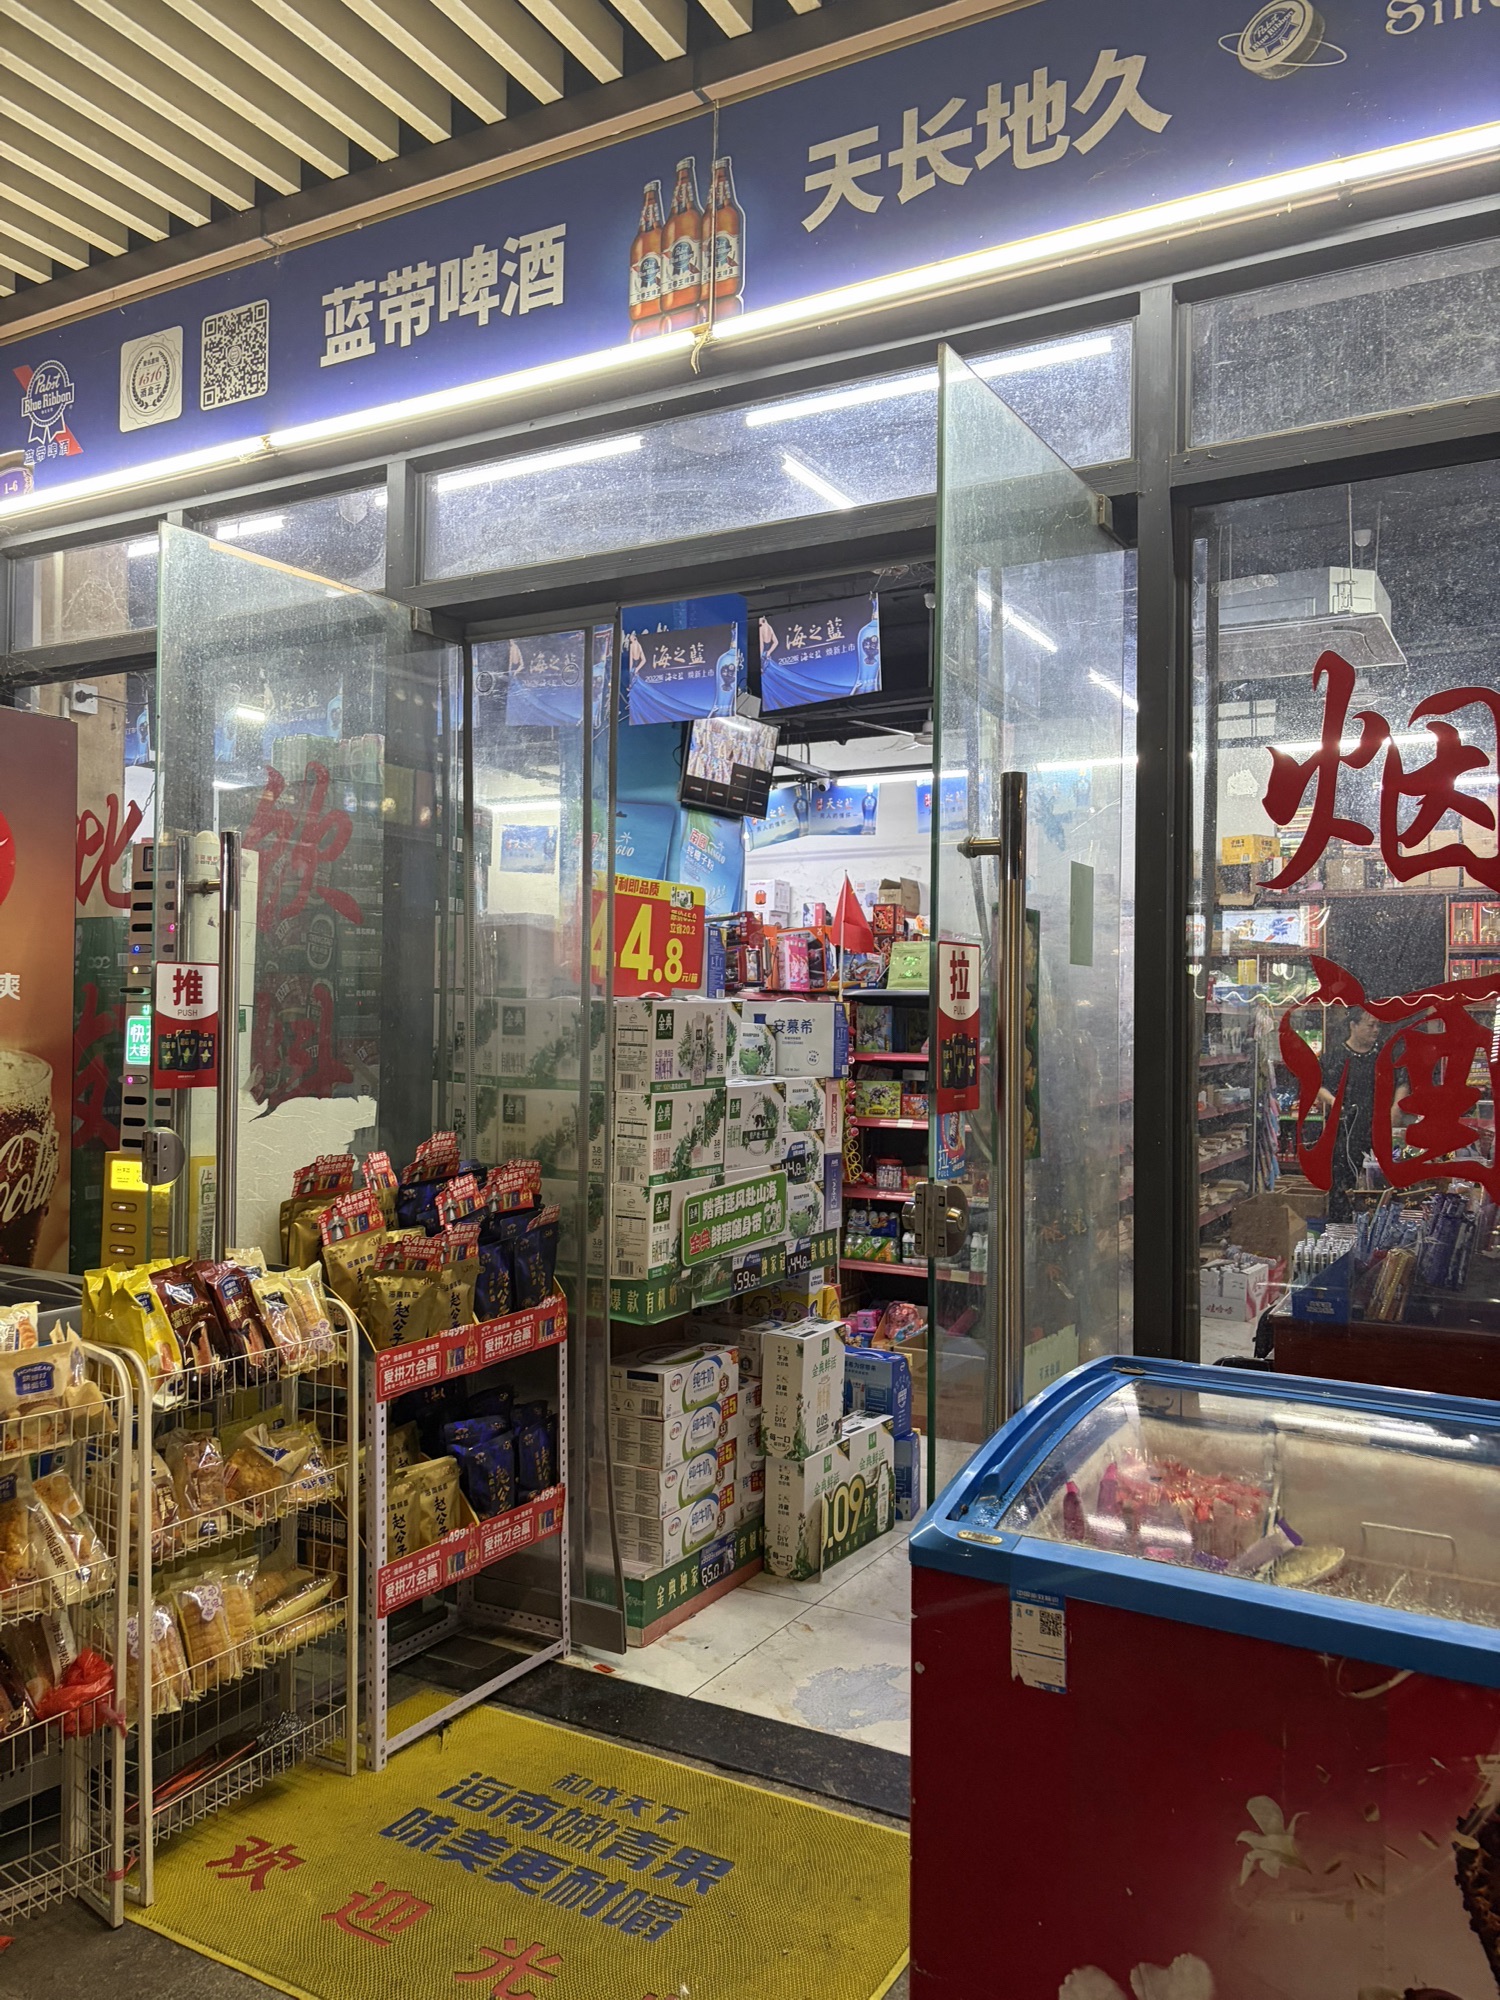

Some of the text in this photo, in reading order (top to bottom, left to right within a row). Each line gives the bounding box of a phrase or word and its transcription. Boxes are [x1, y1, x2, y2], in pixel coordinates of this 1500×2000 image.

[802, 48, 1171, 233] 天长地久
[319, 223, 567, 367] 蓝带啤酒
[34, 373, 61, 395] Pabst
[138, 365, 165, 386] 1516
[24, 391, 72, 414] Blue Ribbon
[172, 968, 203, 1007] 推
[949, 950, 970, 1001] 拉
[177, 1009, 198, 1017] PUSH
[658, 1013, 672, 1031] 金典
[953, 1005, 966, 1015] PULL
[773, 1018, 813, 1035] 安慕希
[657, 1103, 671, 1122] 金典
[938, 1144, 949, 1171] 拉
[655, 1195, 670, 1214] 金典
[702, 1181, 777, 1221] 踏青逐风赴山海
[689, 1211, 762, 1256] 金典鲜醇随身带
[484, 1326, 532, 1353] 爱拼才会赢
[384, 1354, 438, 1386] 爱拼才会赢
[692, 1366, 715, 1389] 纯牛奶
[774, 1416, 787, 1424] DIY
[769, 1432, 791, 1444] 每一口
[484, 1520, 531, 1552] 爱拼才会赢
[776, 1535, 789, 1543] DIY
[772, 1552, 793, 1563] 每一口
[385, 1568, 438, 1600] 爱拼才会赢
[656, 1564, 699, 1610] 金典独家
[550, 1772, 690, 1826] 和成天下
[436, 1770, 737, 1896] 海南嫩青果
[378, 1806, 694, 1943] 味美更耐嚼
